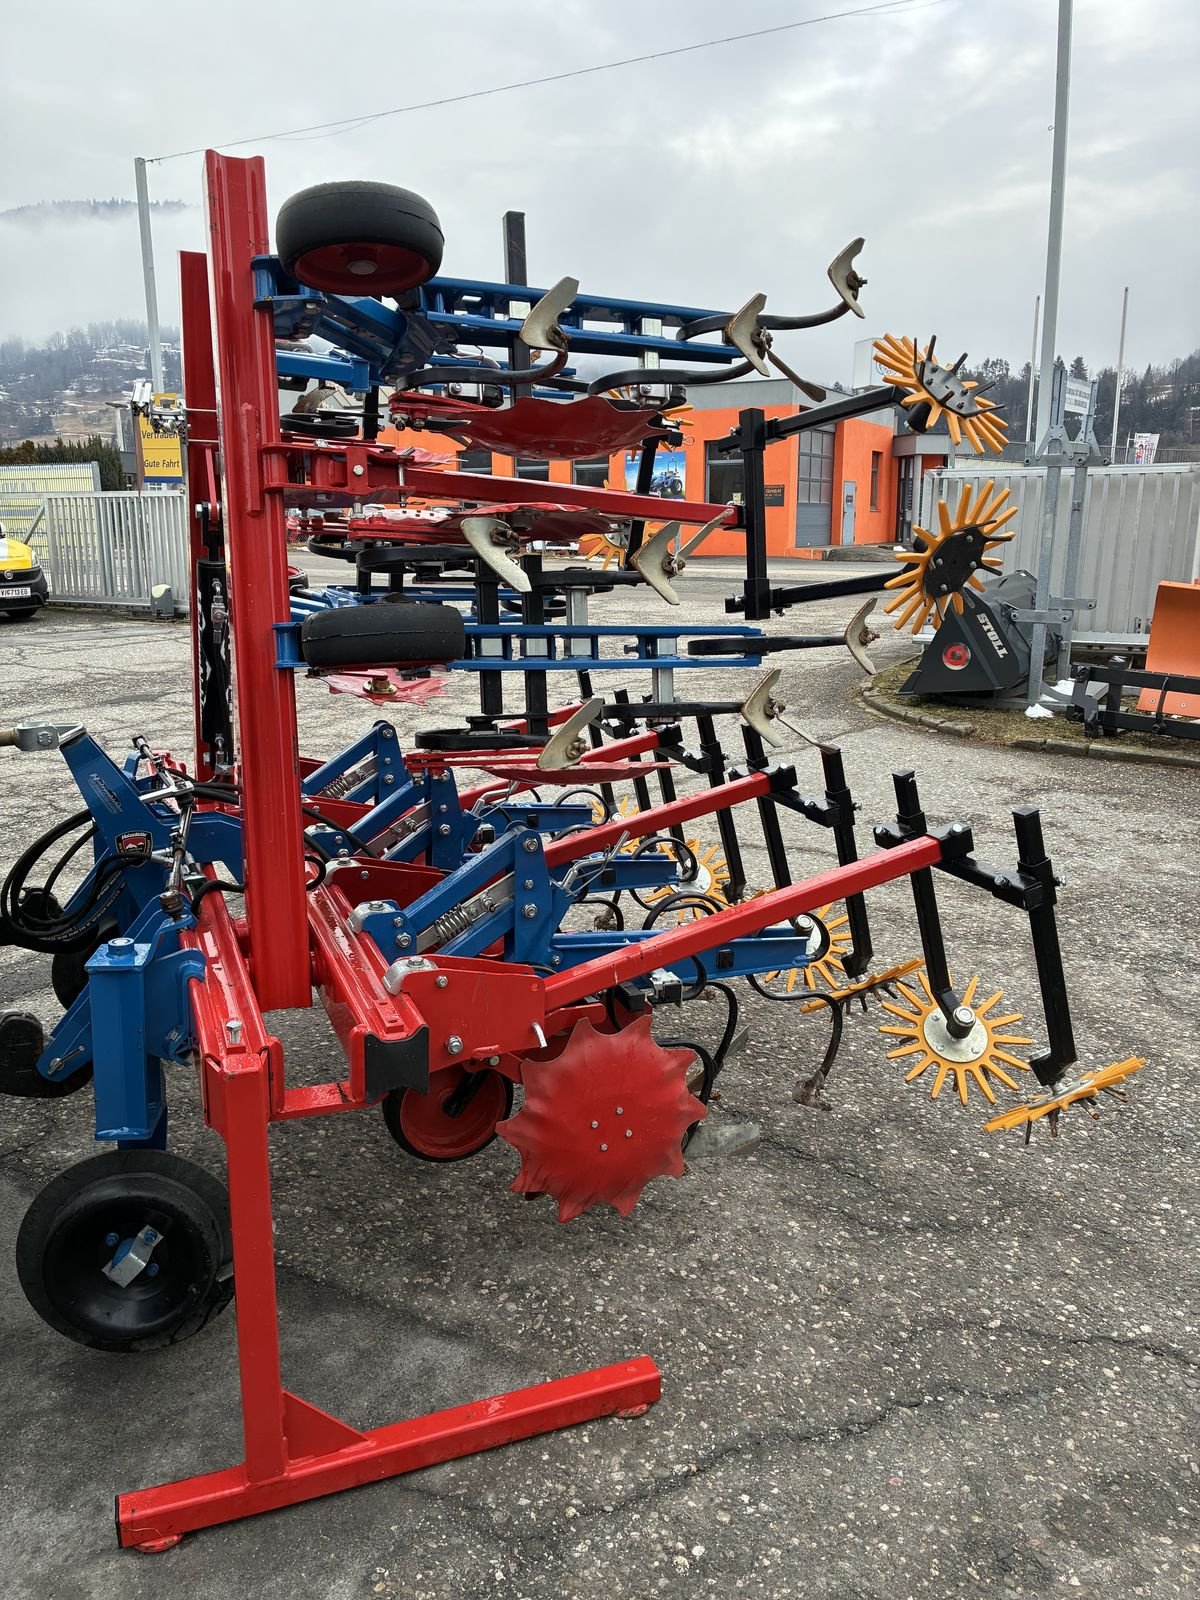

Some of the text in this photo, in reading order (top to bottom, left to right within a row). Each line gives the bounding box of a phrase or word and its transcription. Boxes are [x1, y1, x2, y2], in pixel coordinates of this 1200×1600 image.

[142, 430, 178, 439] Vertrauen
[144, 459, 180, 468] Gute Fahrt
[976, 612, 1009, 659] STOLL
